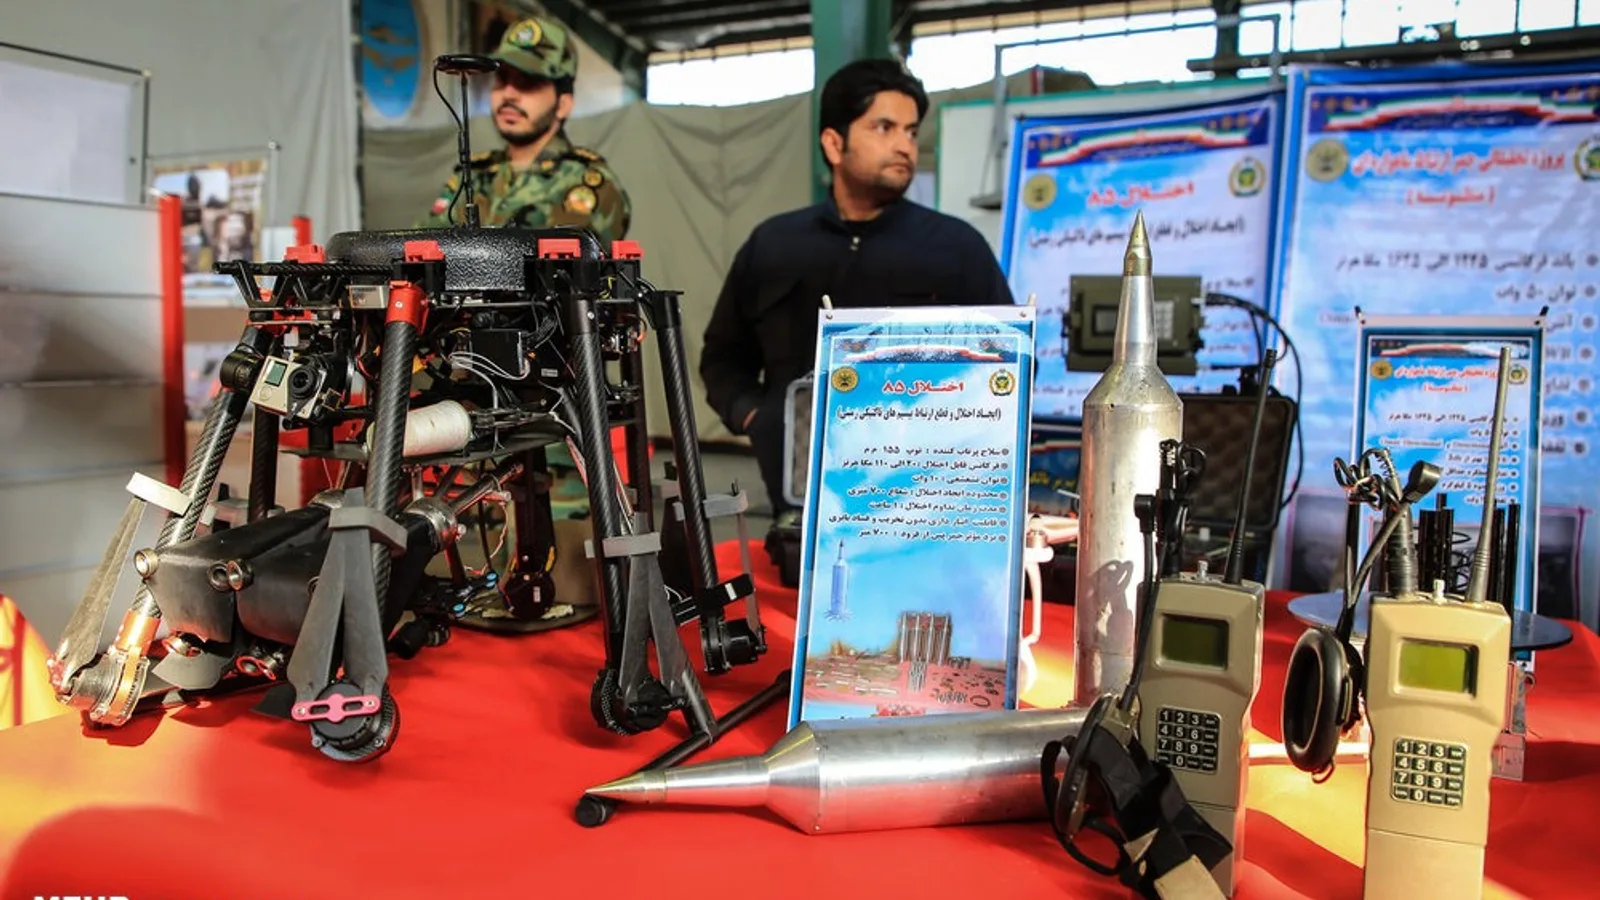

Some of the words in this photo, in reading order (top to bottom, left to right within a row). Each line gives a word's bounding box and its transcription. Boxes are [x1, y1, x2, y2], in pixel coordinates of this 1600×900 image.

[1119, 181, 1195, 207] اختلال
[883, 381, 906, 392] ۸۵
[908, 381, 965, 394] اختلال
[933, 447, 954, 455] کننده
[980, 448, 1001, 457] سلاح
[922, 460, 949, 470] اختلال
[980, 477, 1000, 486] توان
[915, 489, 942, 498] اختلال
[905, 502, 931, 511] اختلال
[1163, 711, 1168, 720] 1
[1177, 712, 1184, 722] 2
[1192, 715, 1199, 724] 3
[1161, 725, 1168, 734] 4
[1176, 727, 1183, 738] 5
[1191, 729, 1198, 739] 6
[1161, 740, 1167, 748] 7
[1176, 741, 1182, 751] 8
[1190, 744, 1198, 753] 9
[1402, 742, 1408, 752] 1
[1418, 744, 1426, 755] 2
[1435, 746, 1444, 756] 3
[1176, 756, 1183, 766] 0
[1400, 757, 1408, 768] 4
[1417, 759, 1425, 770] 5
[1434, 762, 1443, 773] 6
[1399, 773, 1407, 782] 7
[1416, 775, 1424, 786] 8
[1434, 778, 1441, 788] 9
[1415, 790, 1423, 800] 0
